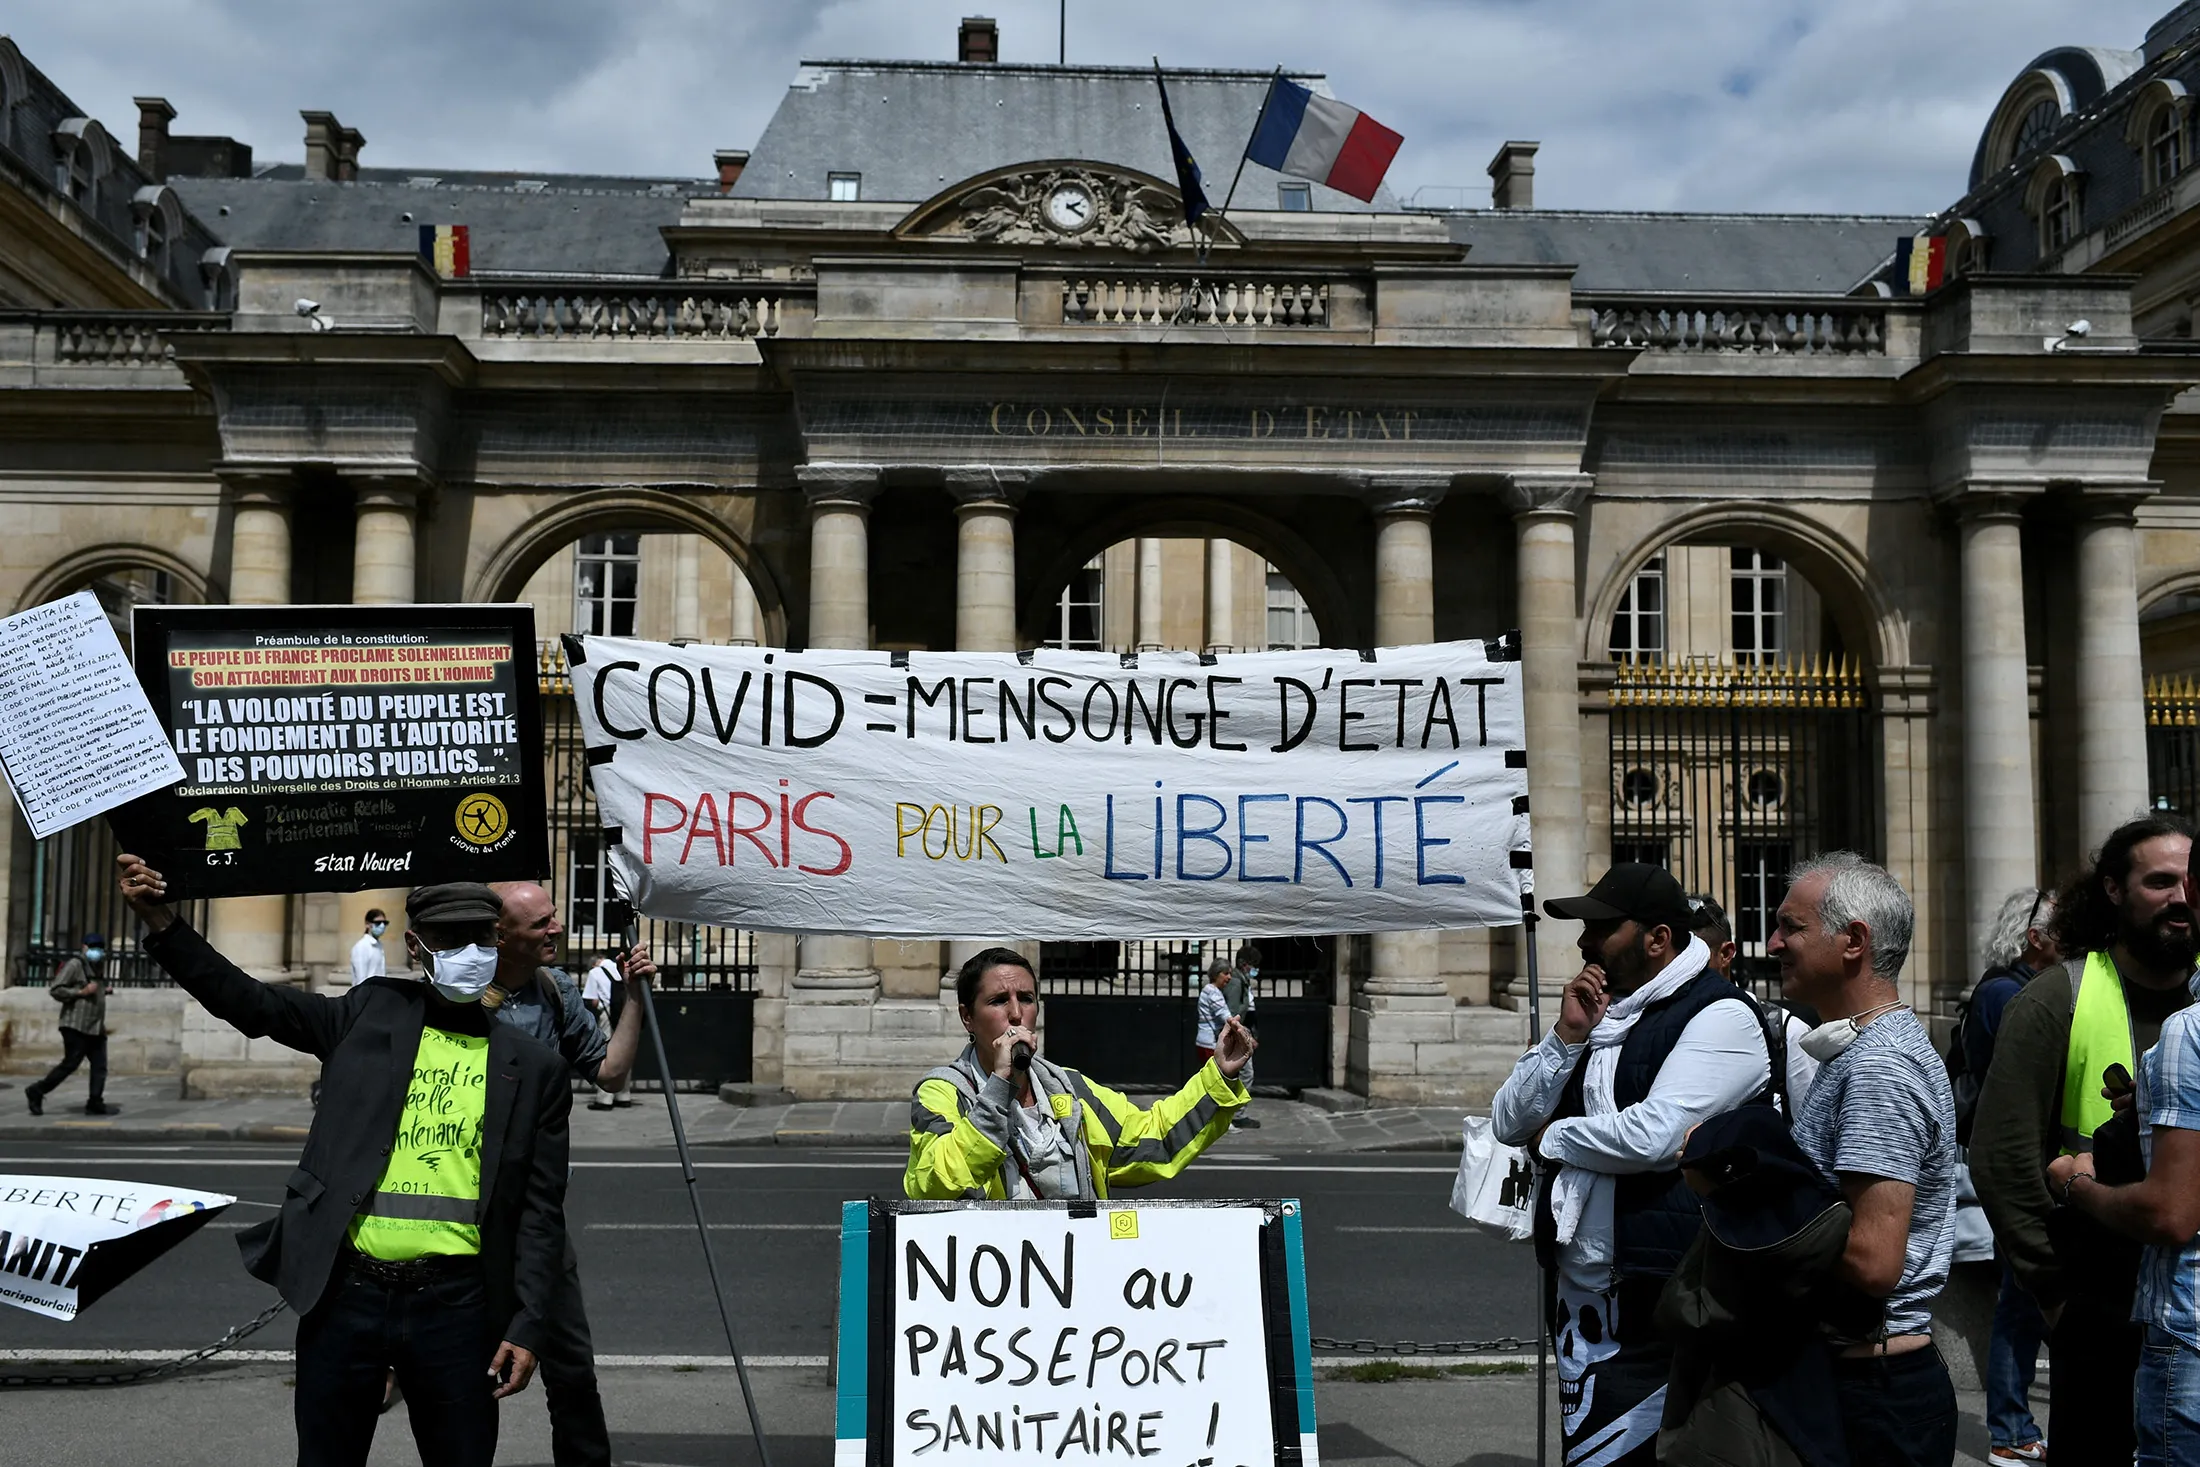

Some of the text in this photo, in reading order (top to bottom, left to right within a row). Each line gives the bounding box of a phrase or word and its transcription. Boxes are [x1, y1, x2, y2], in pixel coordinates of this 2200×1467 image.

[990, 402, 1197, 437] CONSEIL
[58, 615, 73, 623] PAR
[1, 643, 30, 658] ARATION
[32, 637, 44, 645] DES
[69, 624, 77, 632] DE
[256, 634, 428, 646] Préambule de la constitution:
[170, 646, 511, 666] LE PEUPLE DE FRANCE PROCLAME SOLENNELLEMENT
[1, 679, 15, 689] ODE
[20, 679, 48, 692] PÉNAL
[194, 666, 494, 686] SON ATTACHEMENT AUX DROITS DE L'HOMME
[4, 699, 24, 711] CODE
[8, 710, 28, 722] CODE
[227, 691, 336, 724] VOLONTÉ
[340, 696, 374, 721] DU
[378, 693, 462, 720] PEUPLE
[466, 692, 506, 718] EST
[2, 727, 12, 736] LE
[13, 720, 31, 732] CODE
[175, 713, 518, 754] LE FONDEMENT DE L'AUTORITÉ
[7, 737, 18, 746] LE
[17, 755, 29, 764] LA
[22, 764, 32, 773] LE
[196, 756, 245, 783] DES
[250, 749, 375, 781] POUVOIRS
[36, 792, 46, 800] LA
[178, 786, 248, 796] Déclaration
[251, 782, 317, 794] Universelle
[322, 781, 342, 791] des
[345, 780, 380, 790] Droits
[384, 779, 396, 788] de
[400, 777, 450, 788] l'Homme
[460, 775, 496, 786] Article
[500, 774, 520, 784] 21.3
[46, 811, 56, 820] LE
[60, 801, 81, 813] CODE
[85, 796, 93, 804] DE
[264, 798, 396, 824] Démocratie Réelle
[264, 818, 360, 846] Maintenant
[894, 800, 1008, 864] POUR
[1028, 804, 1084, 860] LA
[360, 850, 412, 872] Nourel
[423, 1032, 468, 1049] PARIS
[413, 1061, 485, 1090] ocratie
[406, 1084, 466, 1116] éelle
[0, 1187, 137, 1225] BERTÉ
[905, 1230, 1194, 1311] NON au
[903, 1323, 1228, 1389] PASSEPORT
